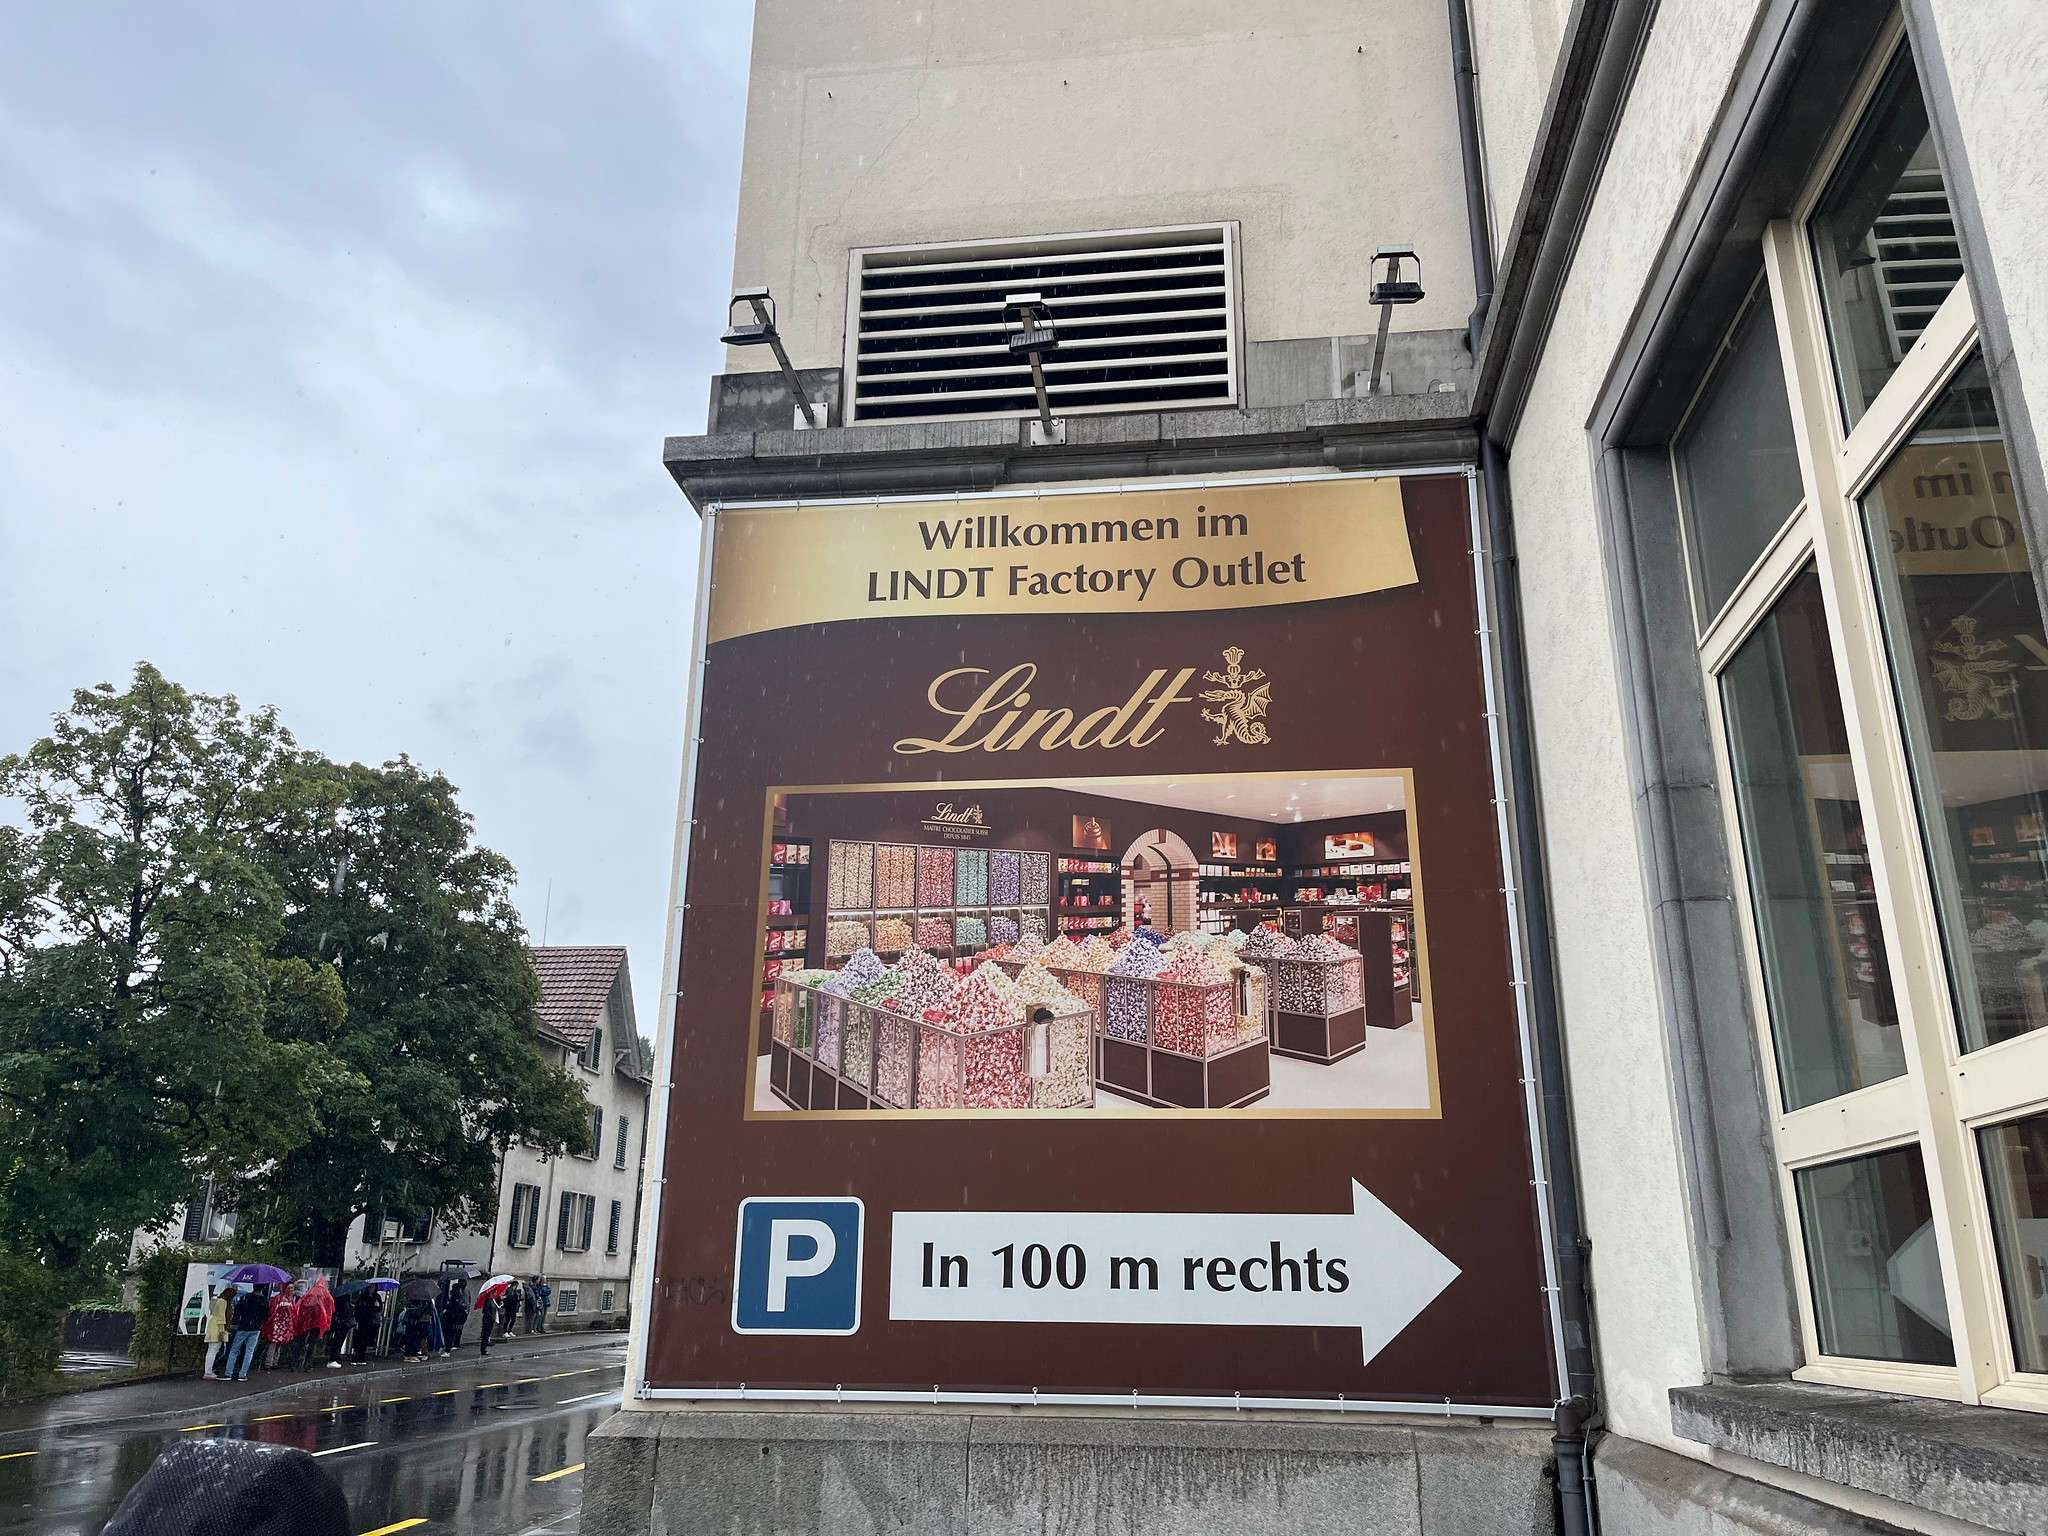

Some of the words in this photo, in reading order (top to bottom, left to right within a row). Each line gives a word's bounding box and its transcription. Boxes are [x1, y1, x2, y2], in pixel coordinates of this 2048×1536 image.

[918, 514, 1179, 551] Willkommen
[1197, 505, 1249, 538] im
[867, 566, 994, 602] LINDT
[1007, 562, 1157, 602] Factory
[1172, 551, 1307, 589] Outlet
[892, 662, 1197, 754] Lindt
[931, 802, 974, 823] Lindt
[766, 1219, 837, 1312] P
[922, 1241, 969, 1288] In
[991, 1242, 1087, 1290] 100
[1110, 1256, 1159, 1291] m
[1183, 1240, 1350, 1294] rechts
